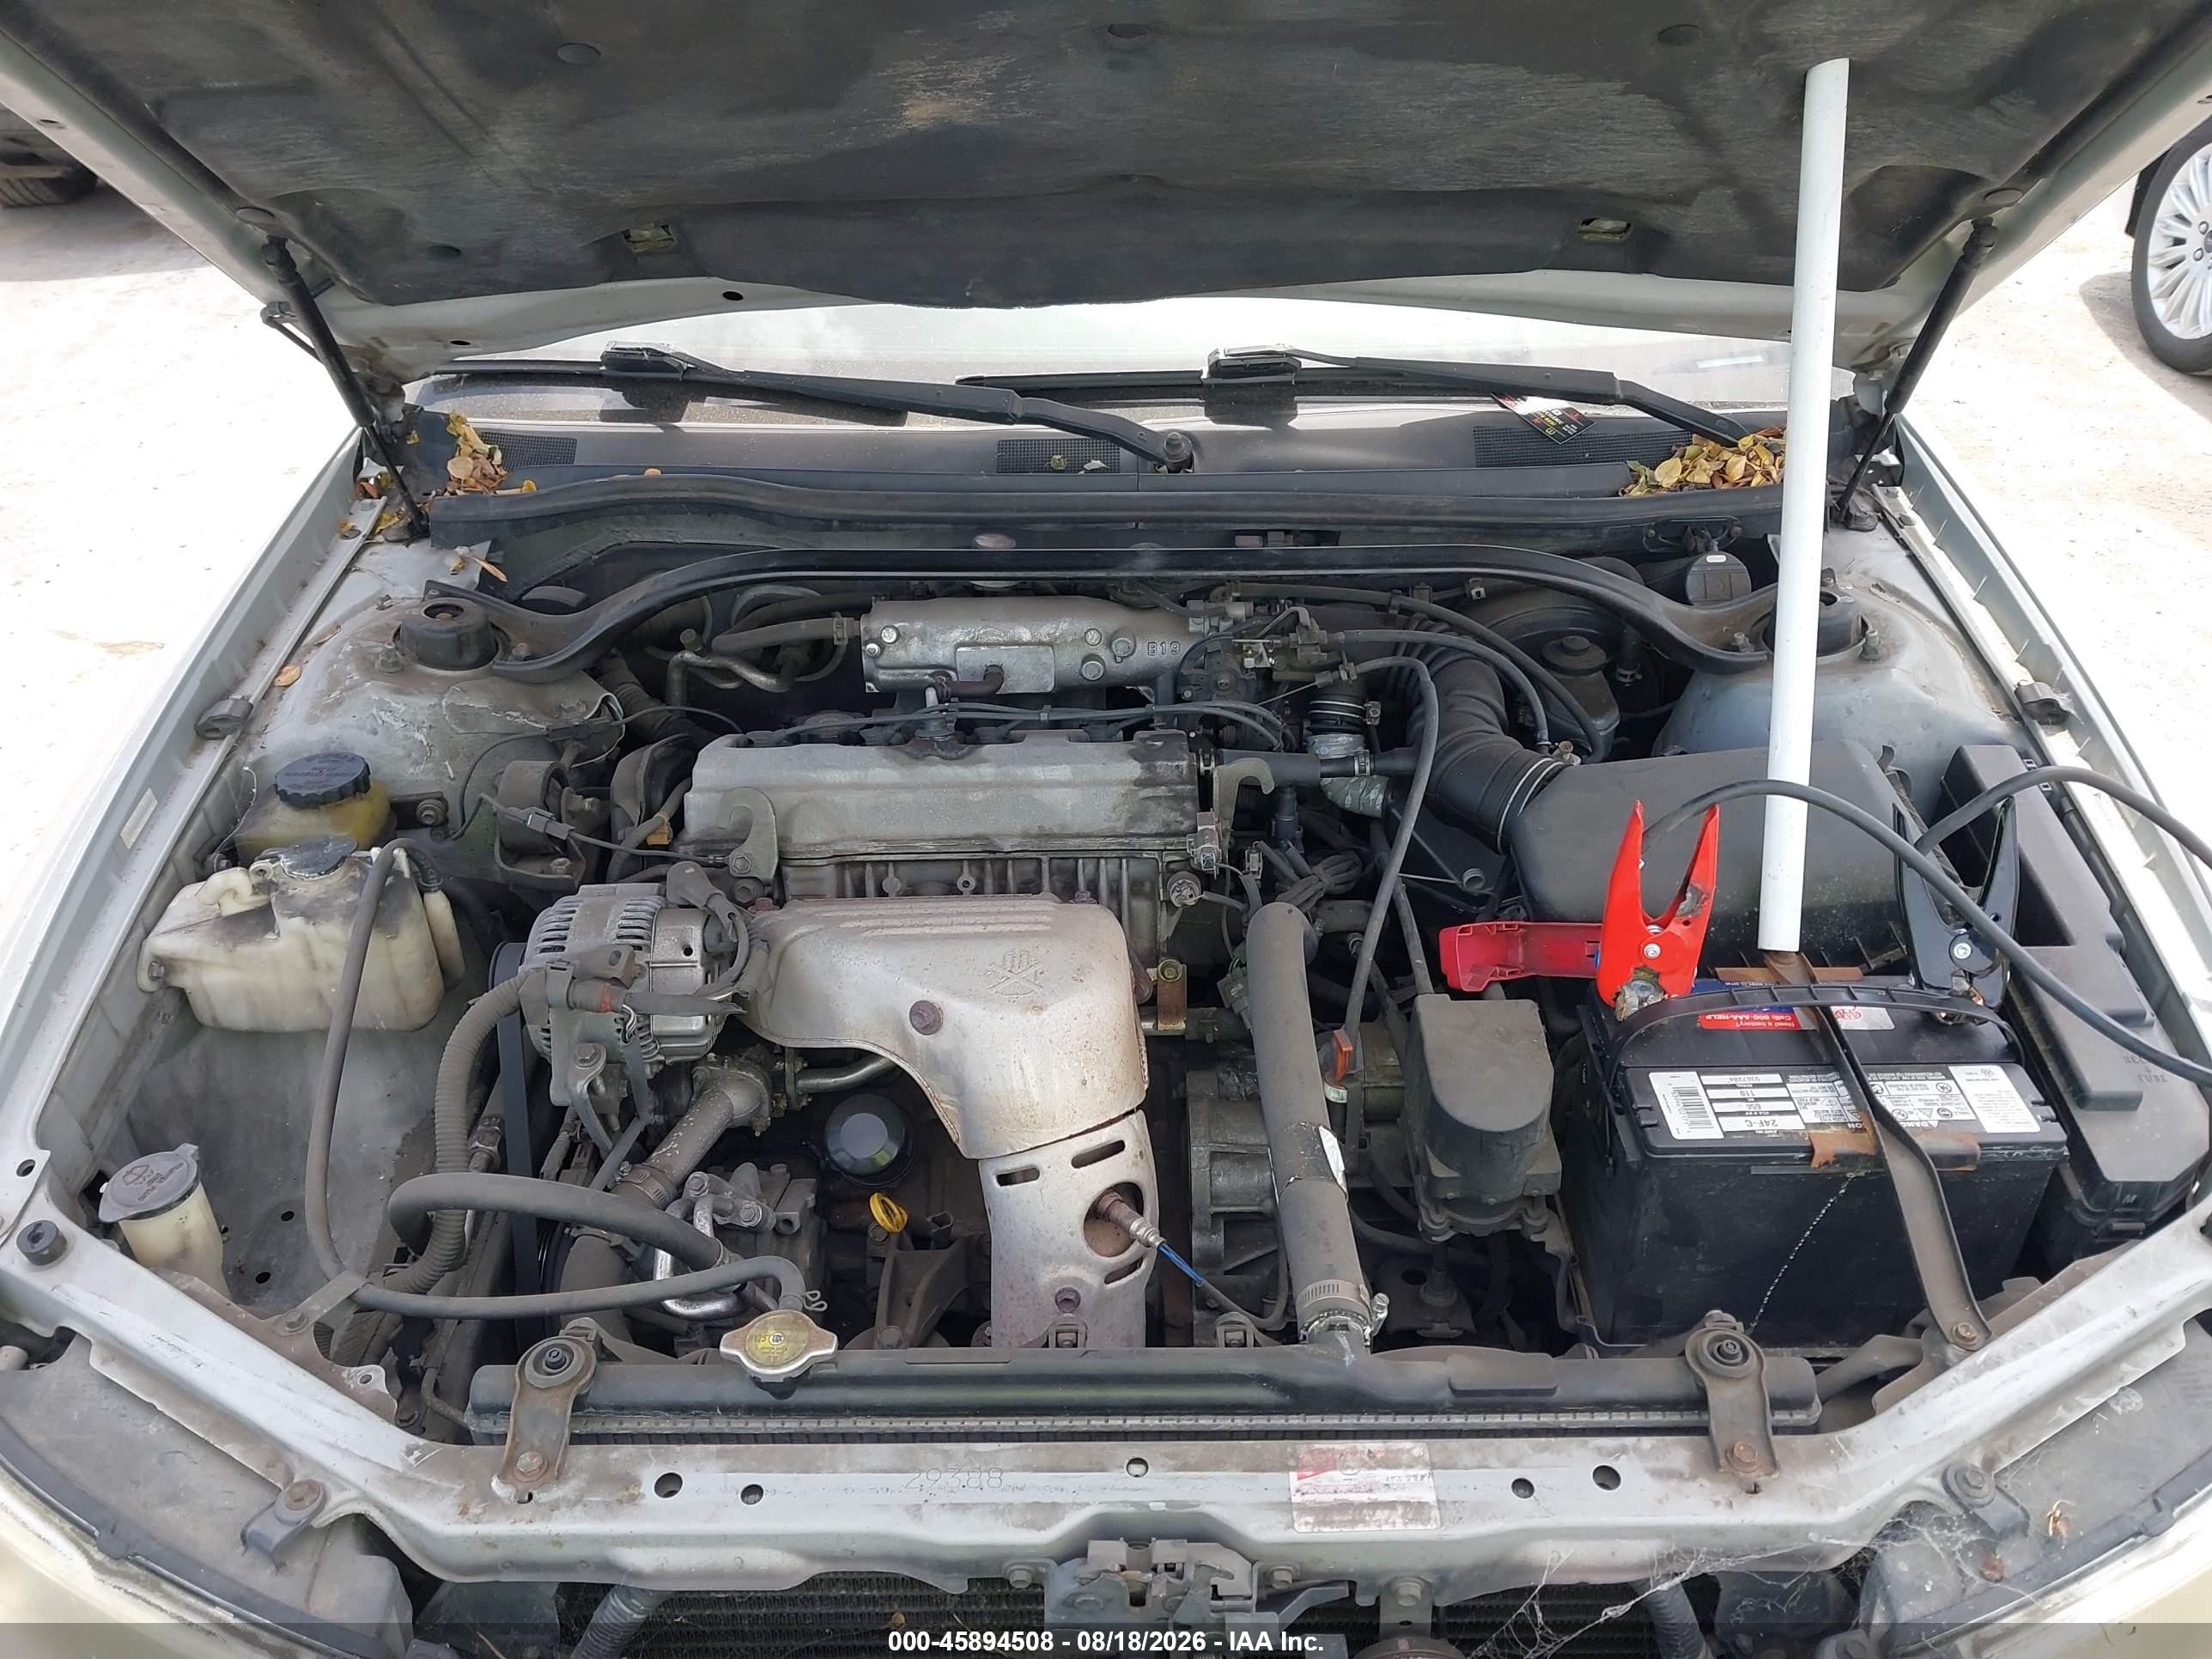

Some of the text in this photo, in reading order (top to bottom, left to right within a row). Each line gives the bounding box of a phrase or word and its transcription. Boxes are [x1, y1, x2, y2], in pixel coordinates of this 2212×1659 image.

[1146, 641, 1182, 657] B19
[1745, 1119, 1778, 1127] 24F-C
[905, 1467, 1003, 1490] 29388
